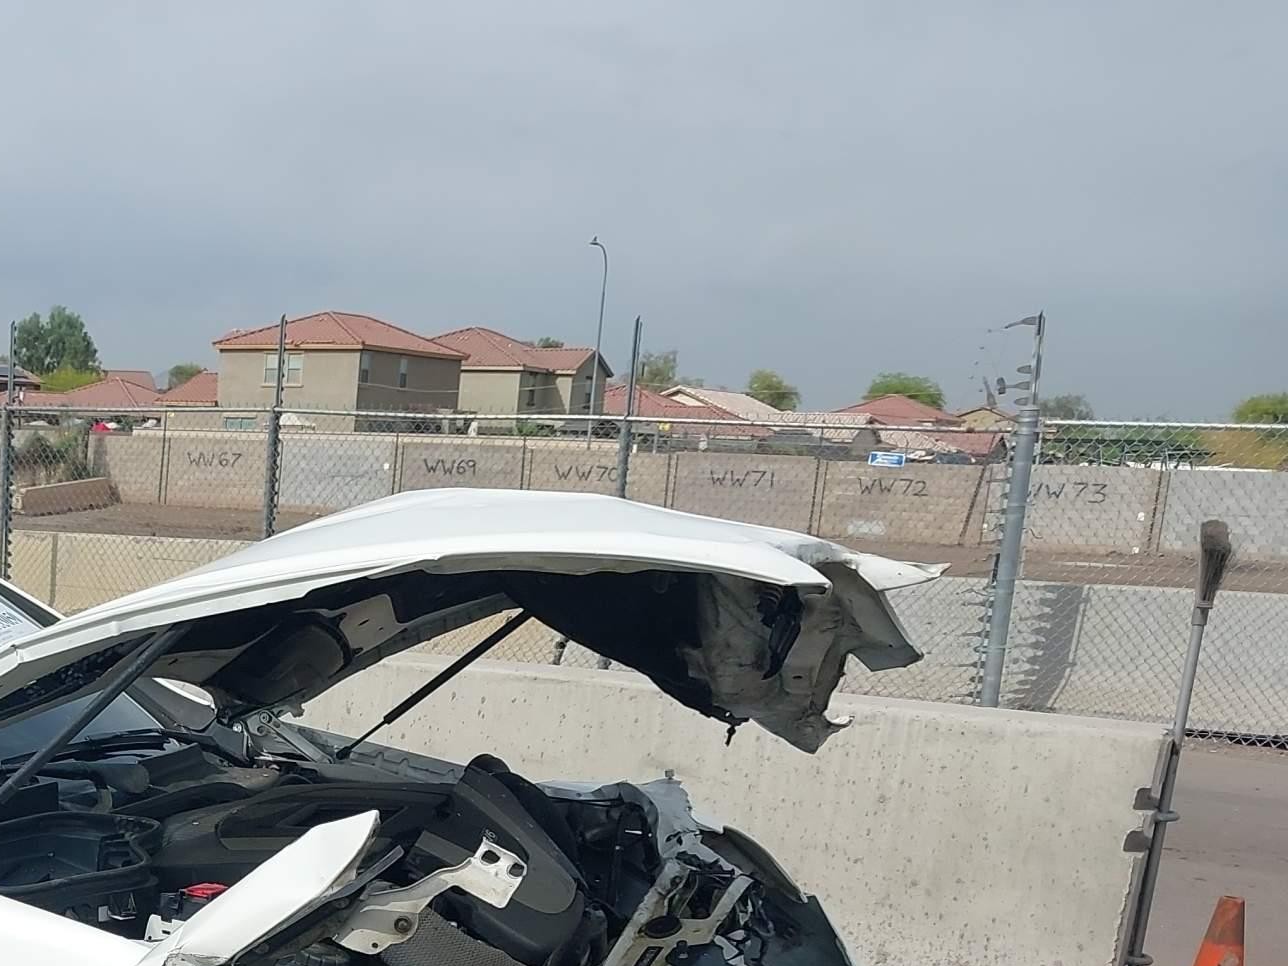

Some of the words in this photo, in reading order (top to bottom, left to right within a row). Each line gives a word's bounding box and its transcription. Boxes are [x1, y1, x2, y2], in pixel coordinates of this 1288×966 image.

[424, 458, 476, 477] WW69
[710, 469, 775, 488] WW71
[858, 477, 929, 496] WW72
